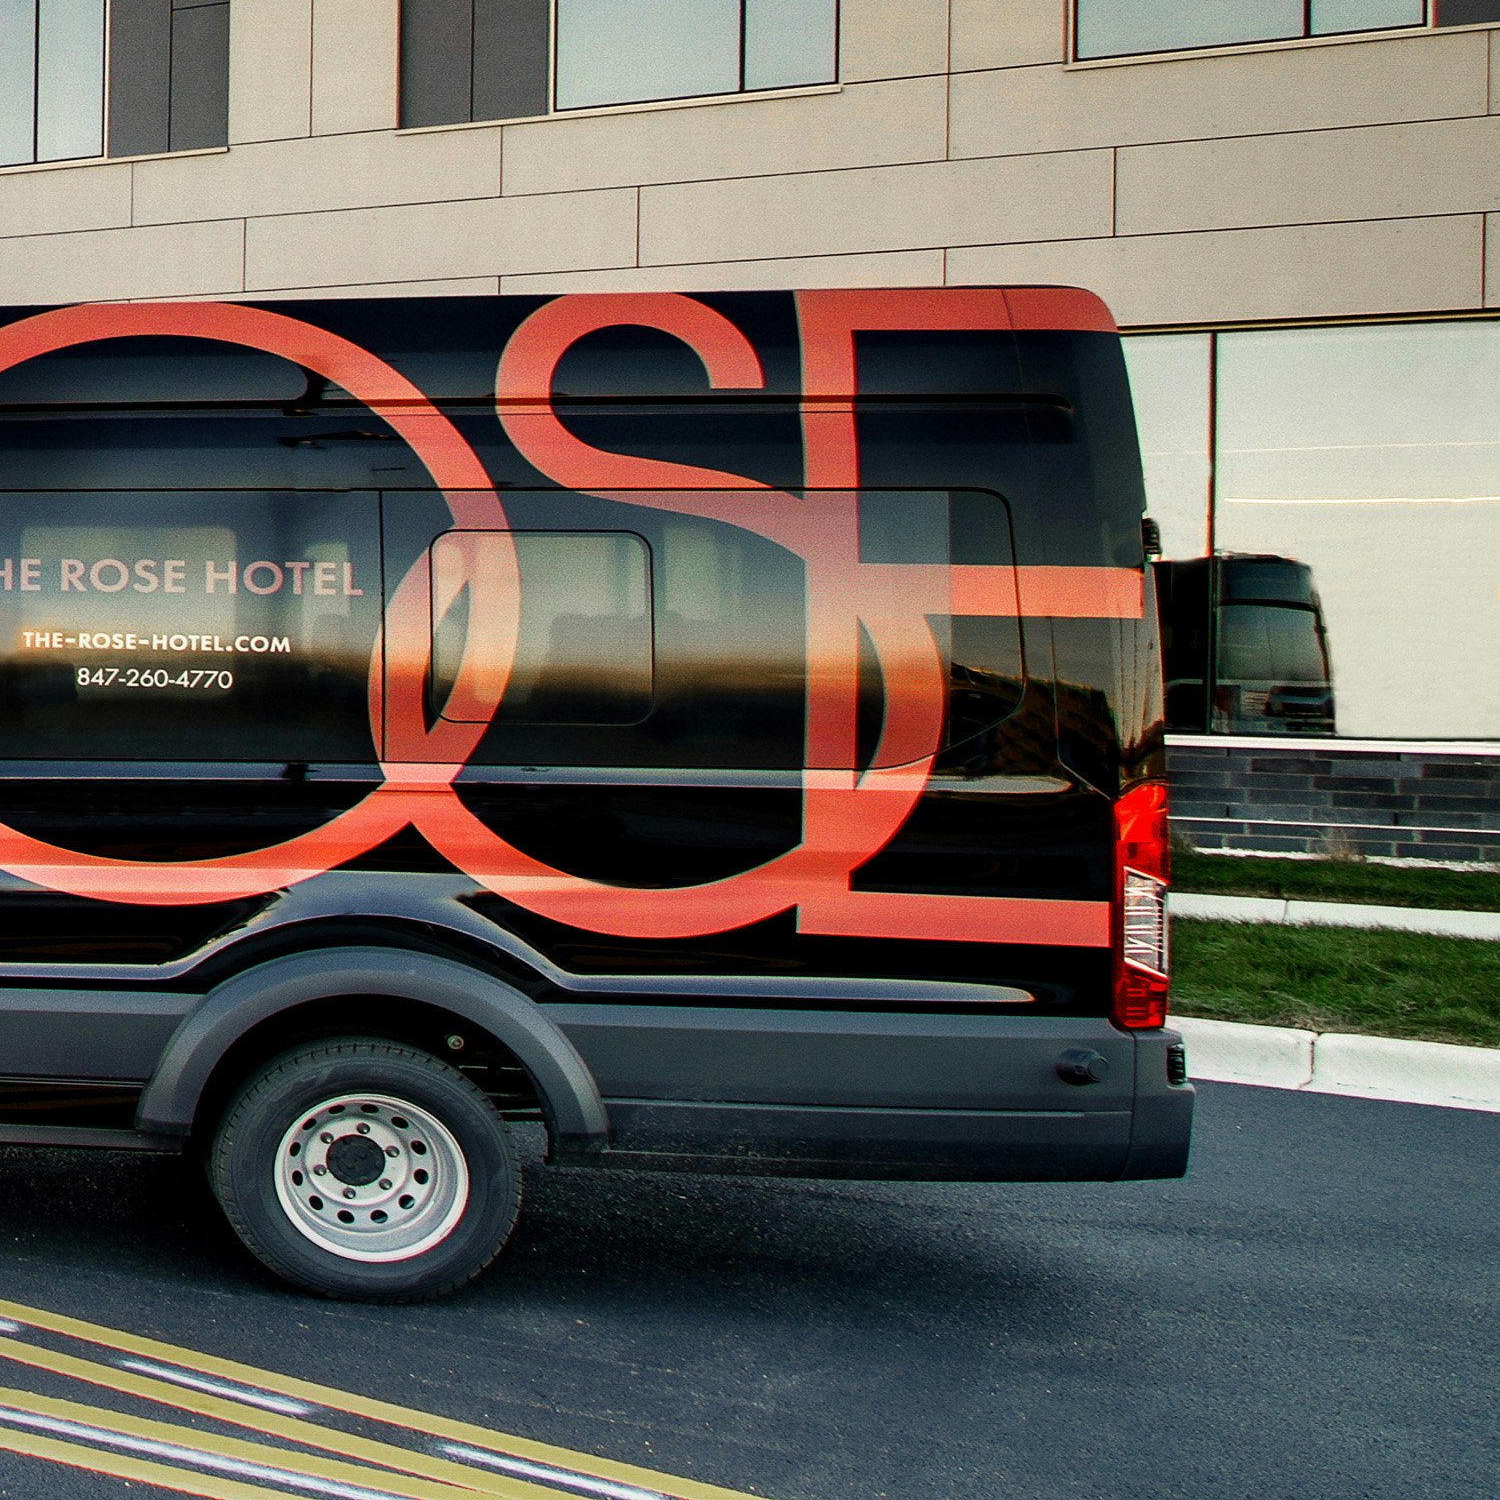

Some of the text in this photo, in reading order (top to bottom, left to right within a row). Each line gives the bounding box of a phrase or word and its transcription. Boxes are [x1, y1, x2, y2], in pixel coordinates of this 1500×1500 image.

[59, 558, 187, 594] ROSE
[204, 559, 365, 597] HOTEL
[22, 630, 292, 654] THE-ROSE-HOTEL.COM
[76, 666, 235, 690] 847-260-4770
